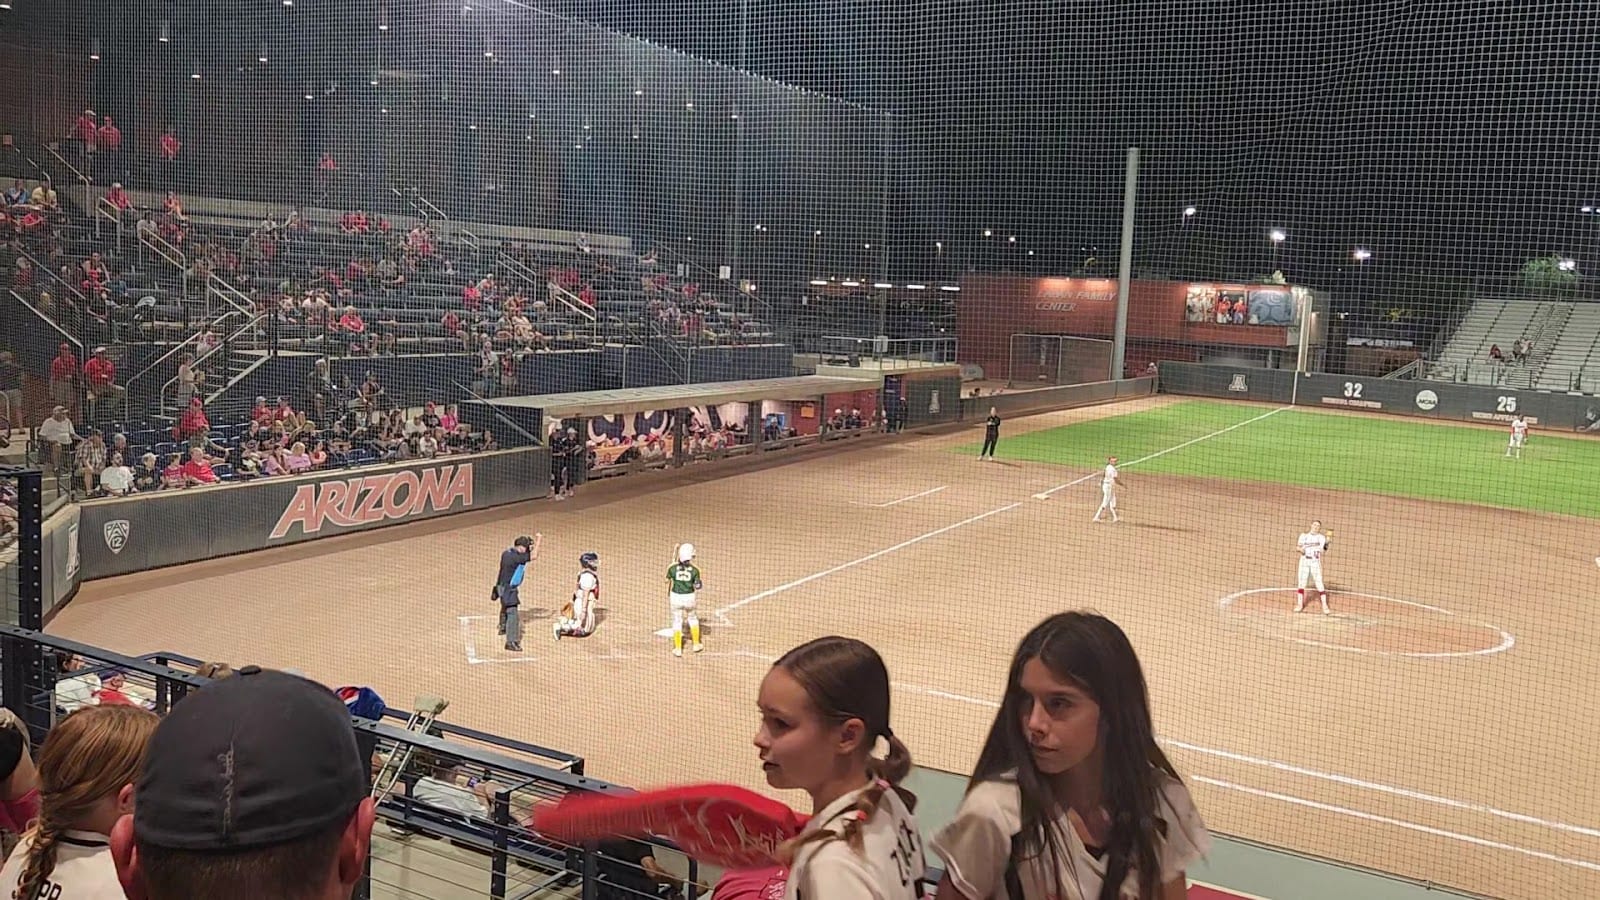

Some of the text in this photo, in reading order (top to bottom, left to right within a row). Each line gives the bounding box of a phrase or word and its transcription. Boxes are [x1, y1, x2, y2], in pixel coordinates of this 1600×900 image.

[1076, 291, 1117, 301] FAMILY
[1035, 302, 1077, 312] CENTER
[1344, 382, 1363, 397] 32
[1497, 396, 1517, 412] 25
[268, 462, 473, 540] ARIZONA
[105, 522, 129, 537] PAC
[111, 537, 122, 548] 12
